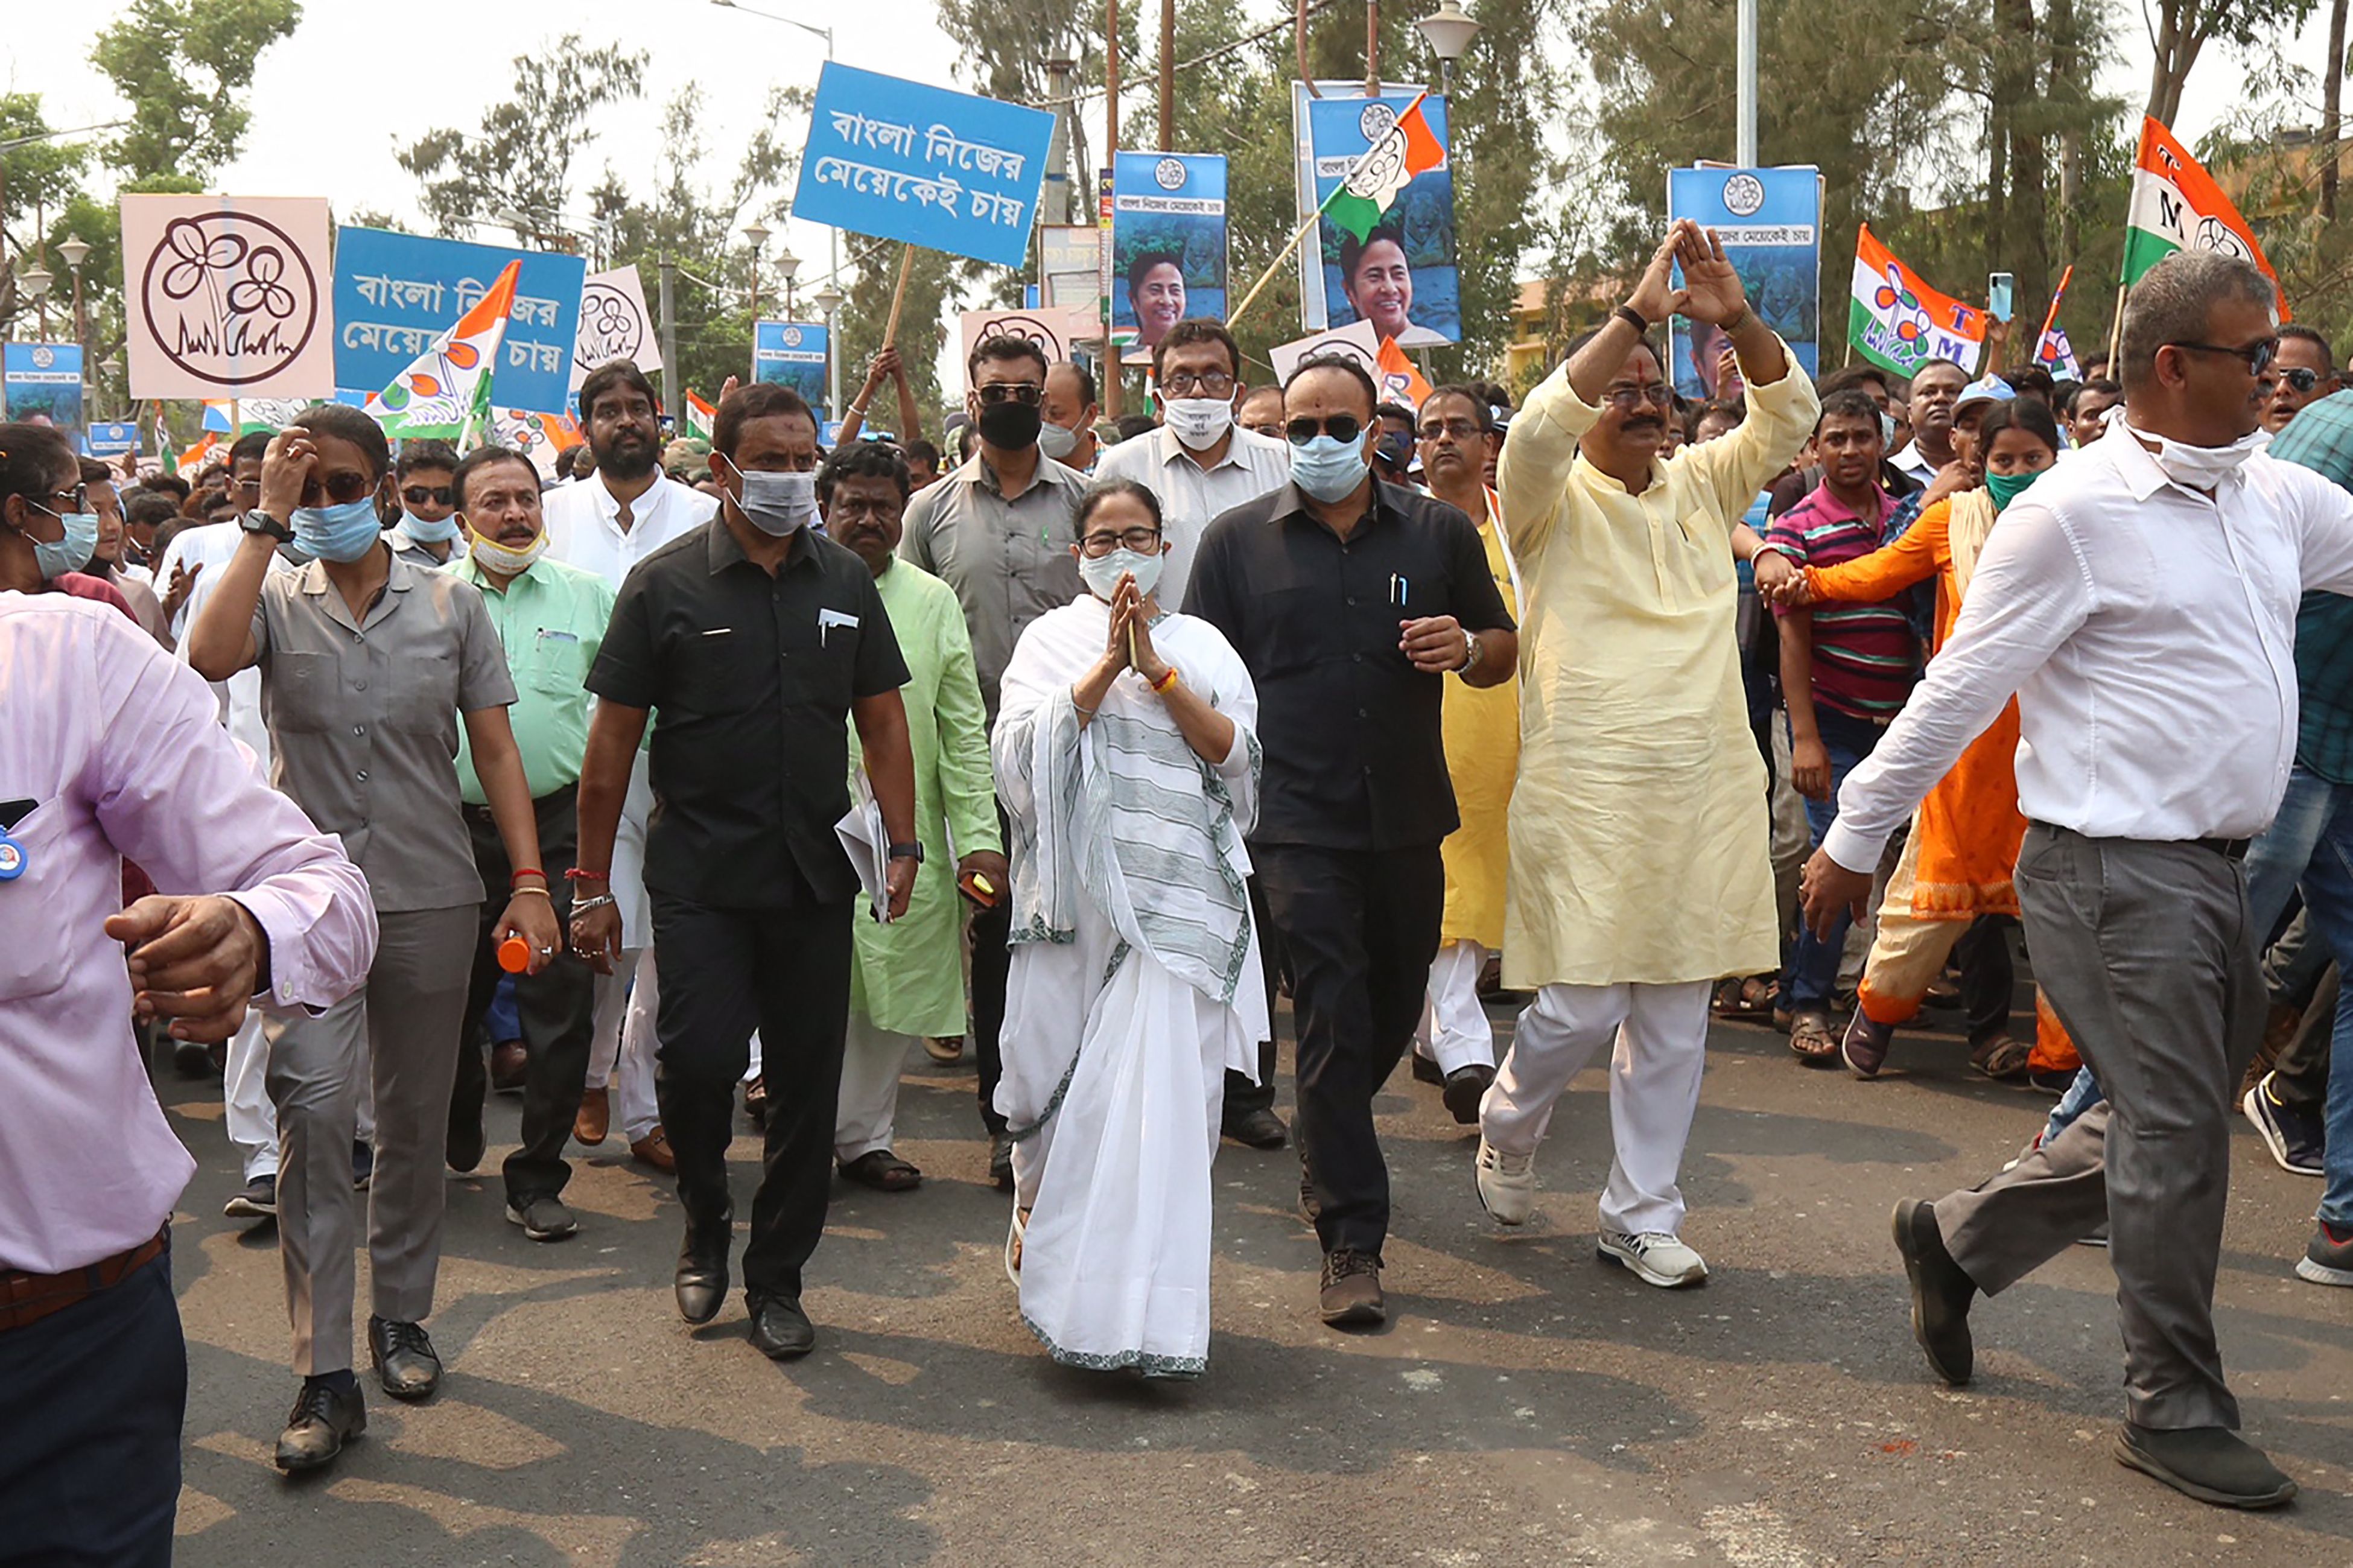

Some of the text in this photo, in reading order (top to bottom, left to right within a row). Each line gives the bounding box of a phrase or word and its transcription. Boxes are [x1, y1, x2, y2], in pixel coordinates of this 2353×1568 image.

[830, 109, 1026, 182] বাংলা নিজের
[815, 156, 1024, 228] মেয়েকেই চায়
[2160, 187, 2185, 241] M
[353, 274, 446, 313] বাংলা
[1949, 303, 1975, 334] T.
[506, 339, 564, 374] চায়
